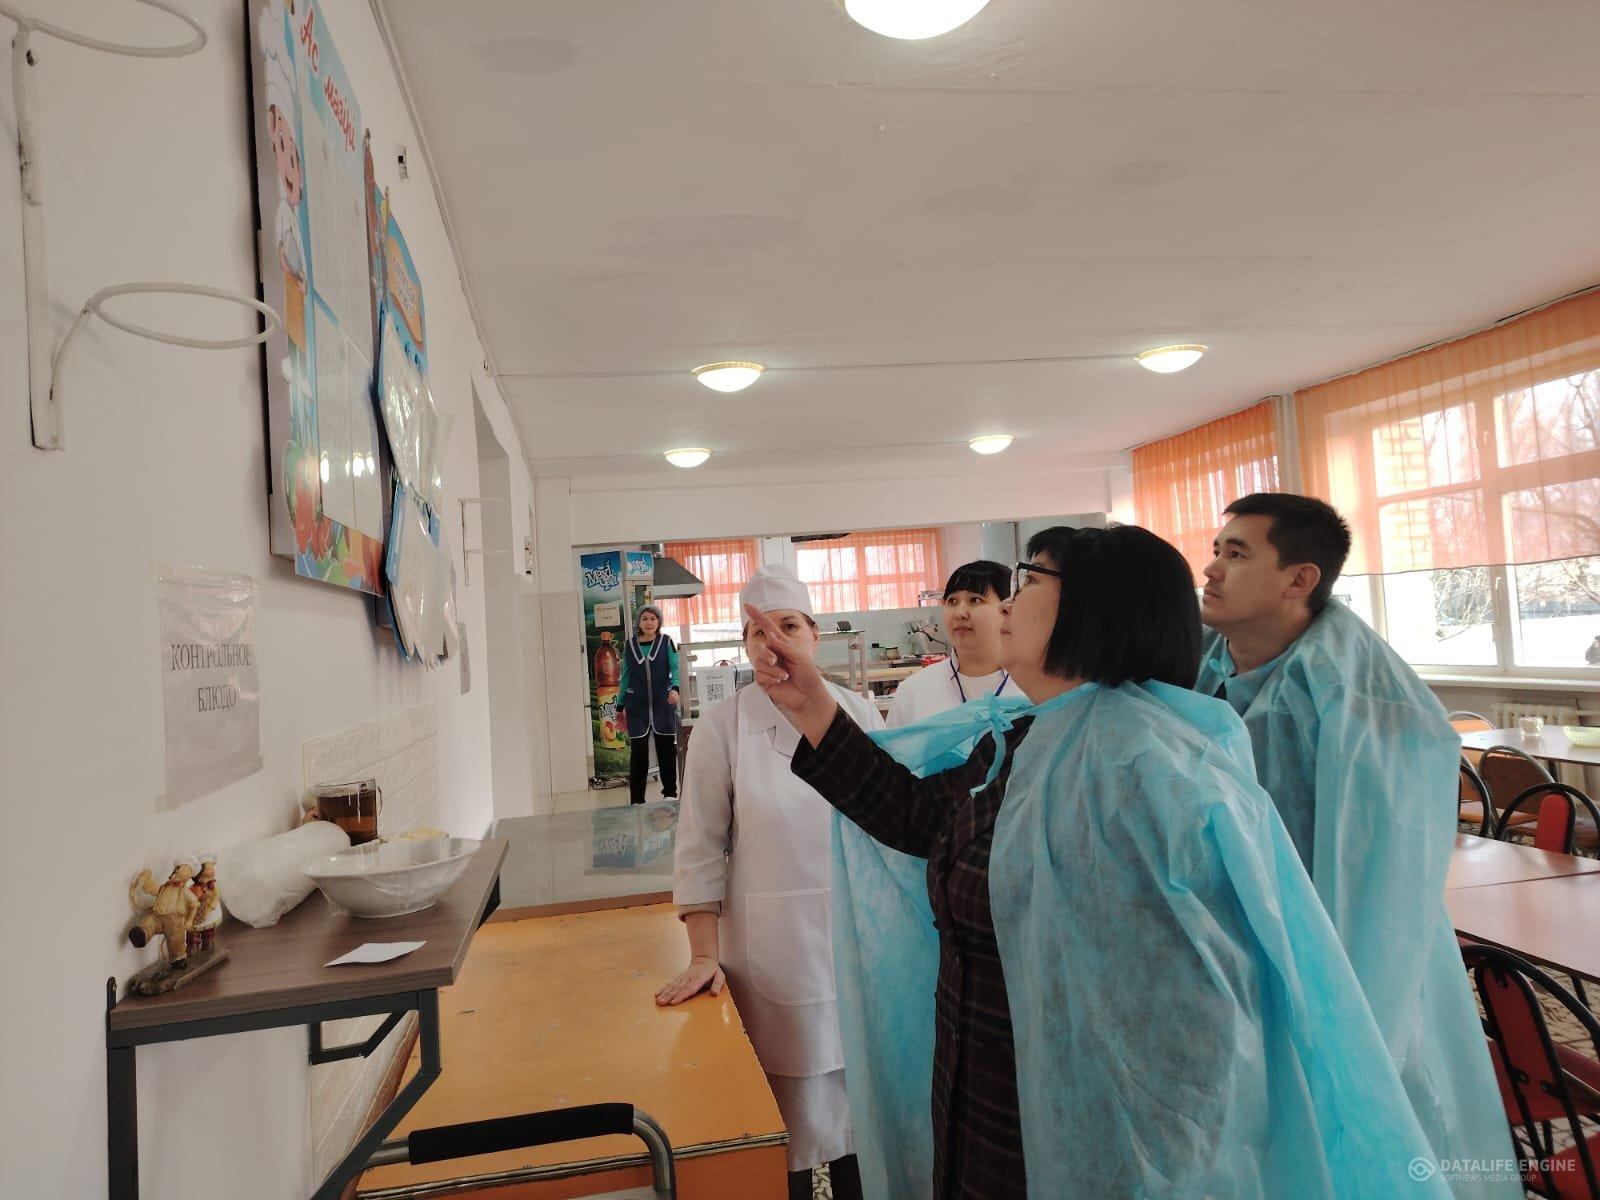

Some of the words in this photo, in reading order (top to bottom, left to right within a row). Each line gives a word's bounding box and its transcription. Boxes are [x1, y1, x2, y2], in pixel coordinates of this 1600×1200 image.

[300, 7, 319, 73] Ас
[171, 643, 252, 671] КОНТРОЛЬНОЕ
[198, 684, 237, 713] БЛЮДО
